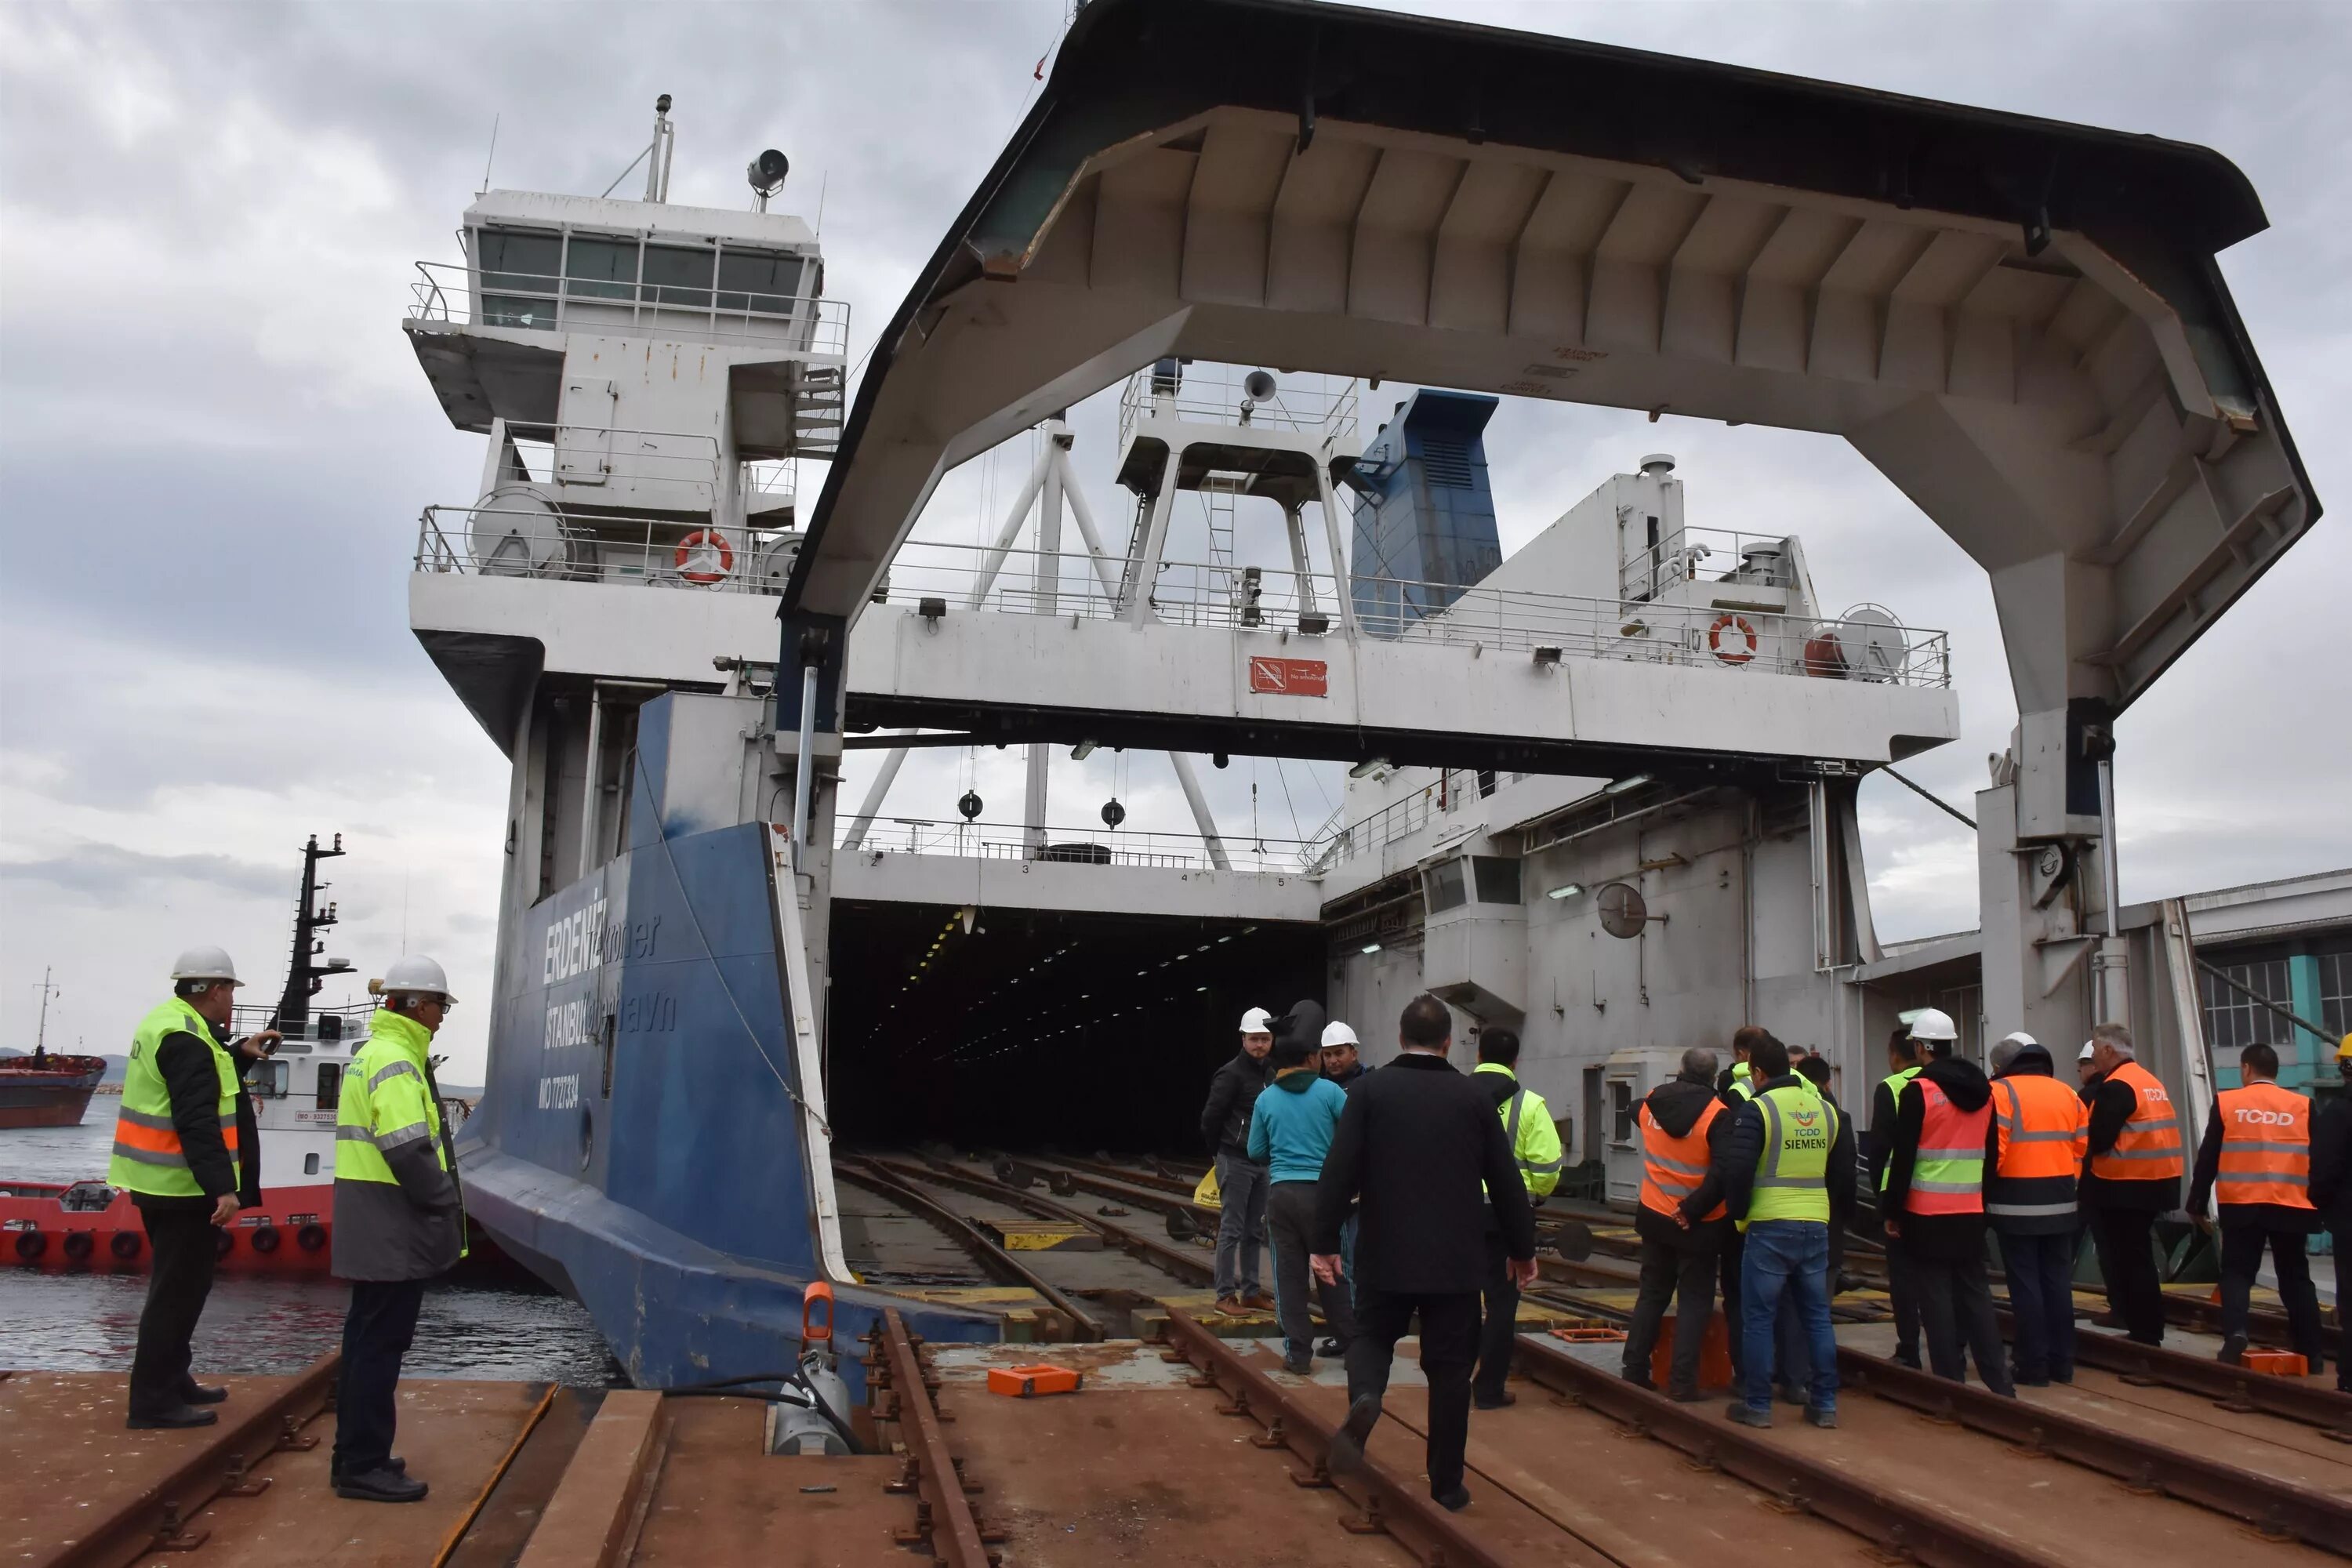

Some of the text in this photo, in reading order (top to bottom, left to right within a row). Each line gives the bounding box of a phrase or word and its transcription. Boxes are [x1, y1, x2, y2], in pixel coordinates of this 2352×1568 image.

[871, 858, 877, 866] 2
[1022, 865, 1029, 873] 3
[543, 887, 608, 985] ERDENİZ
[2234, 1109, 2294, 1126] TCDD
[1794, 1128, 1820, 1137] TCDD
[1784, 1138, 1826, 1150] SIEMENS
